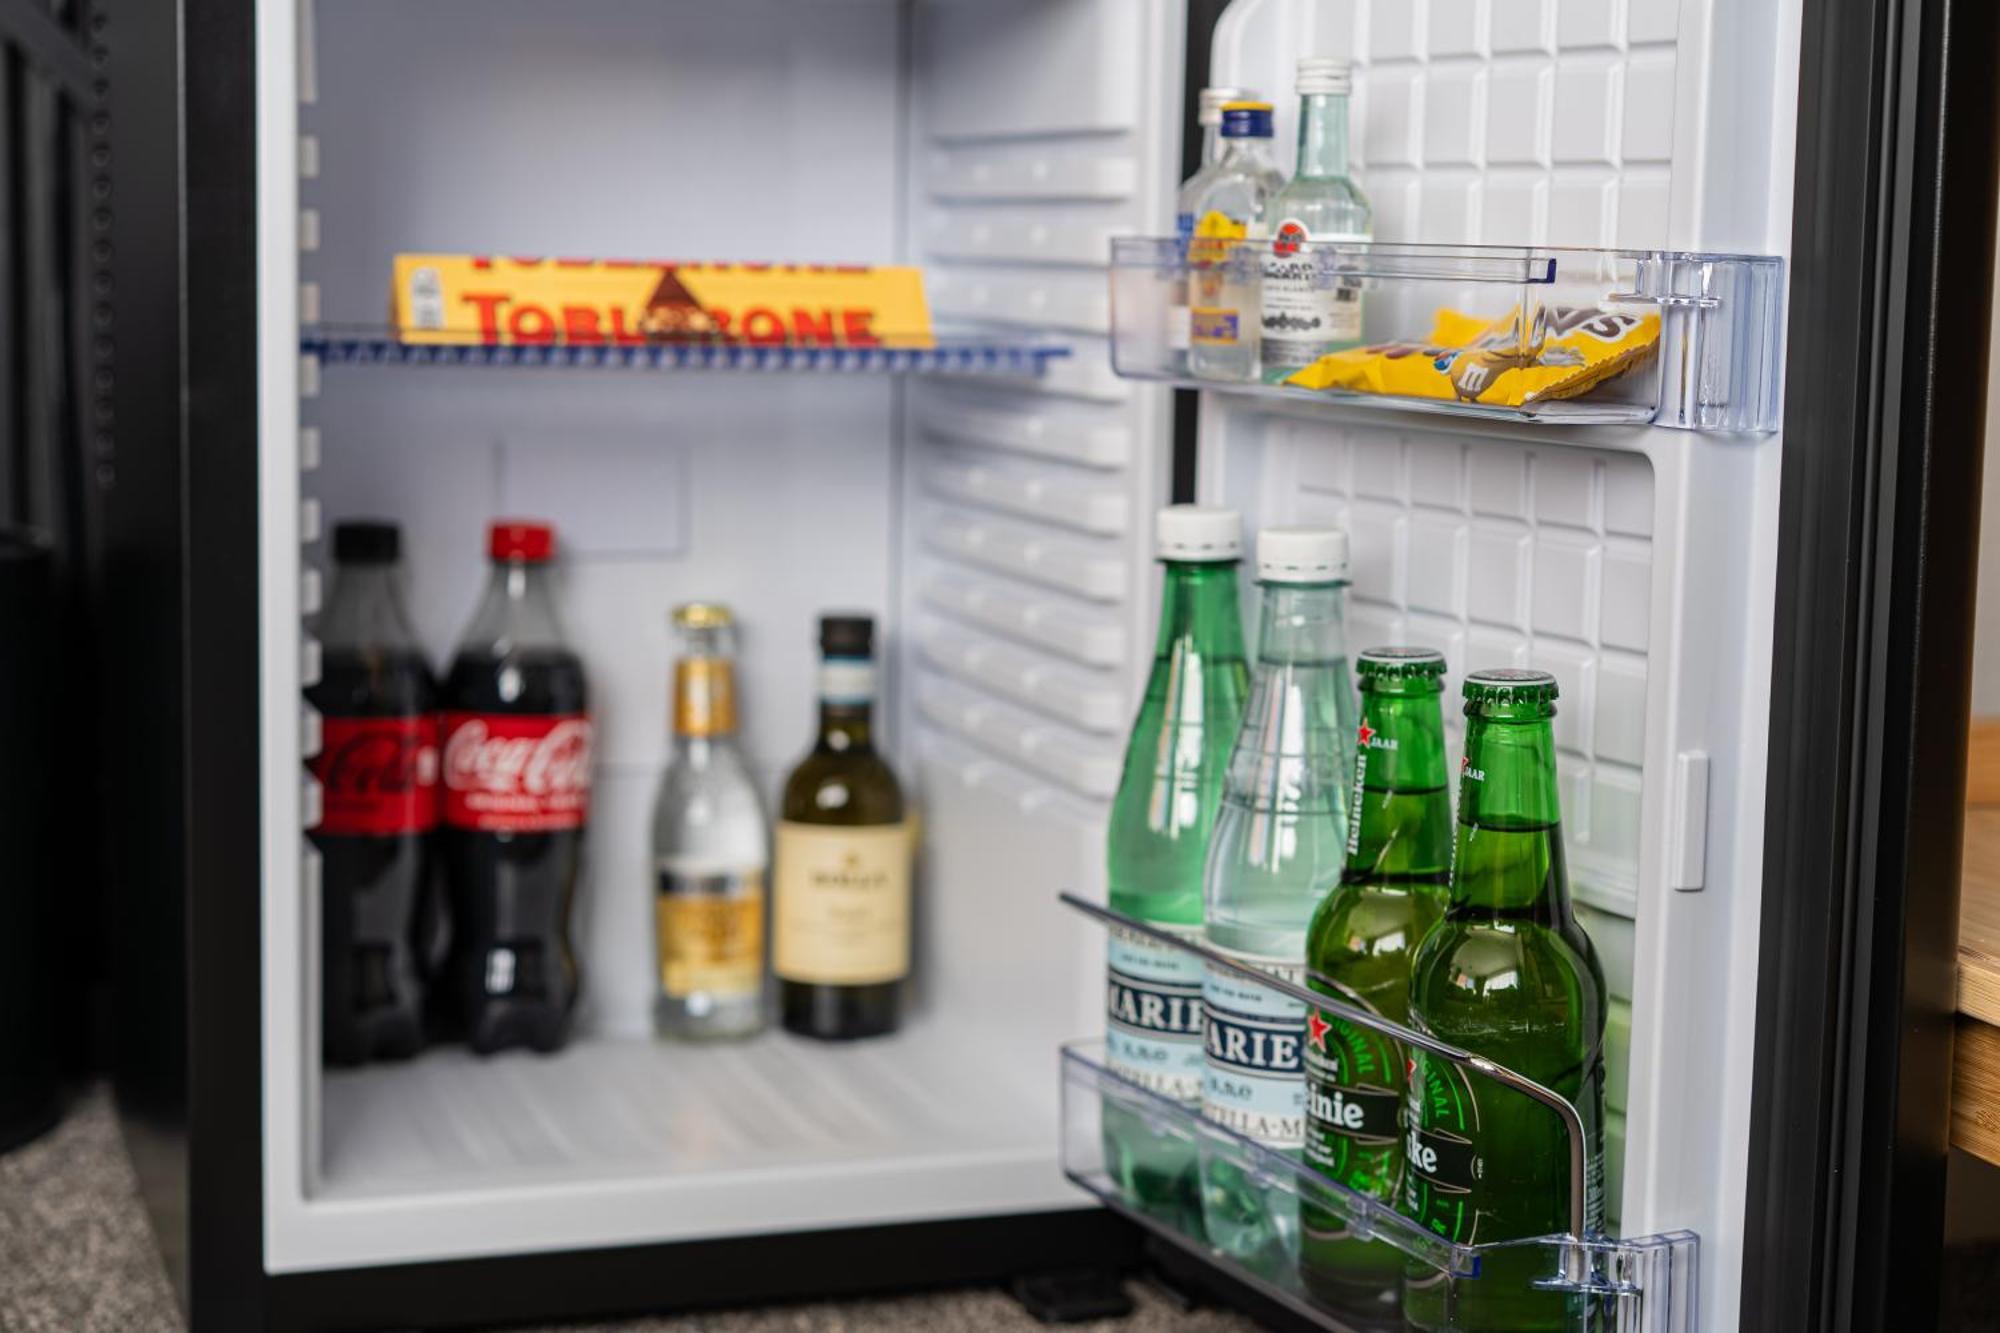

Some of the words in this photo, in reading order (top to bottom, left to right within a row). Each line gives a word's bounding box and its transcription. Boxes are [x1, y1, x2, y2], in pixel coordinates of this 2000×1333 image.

[463, 293, 884, 347] TOBLRONE
[1371, 737, 1398, 750] JAAR
[1348, 754, 1368, 856] Heineken
[1207, 1021, 1300, 1069] ARIE
[1309, 1083, 1364, 1130] inie
